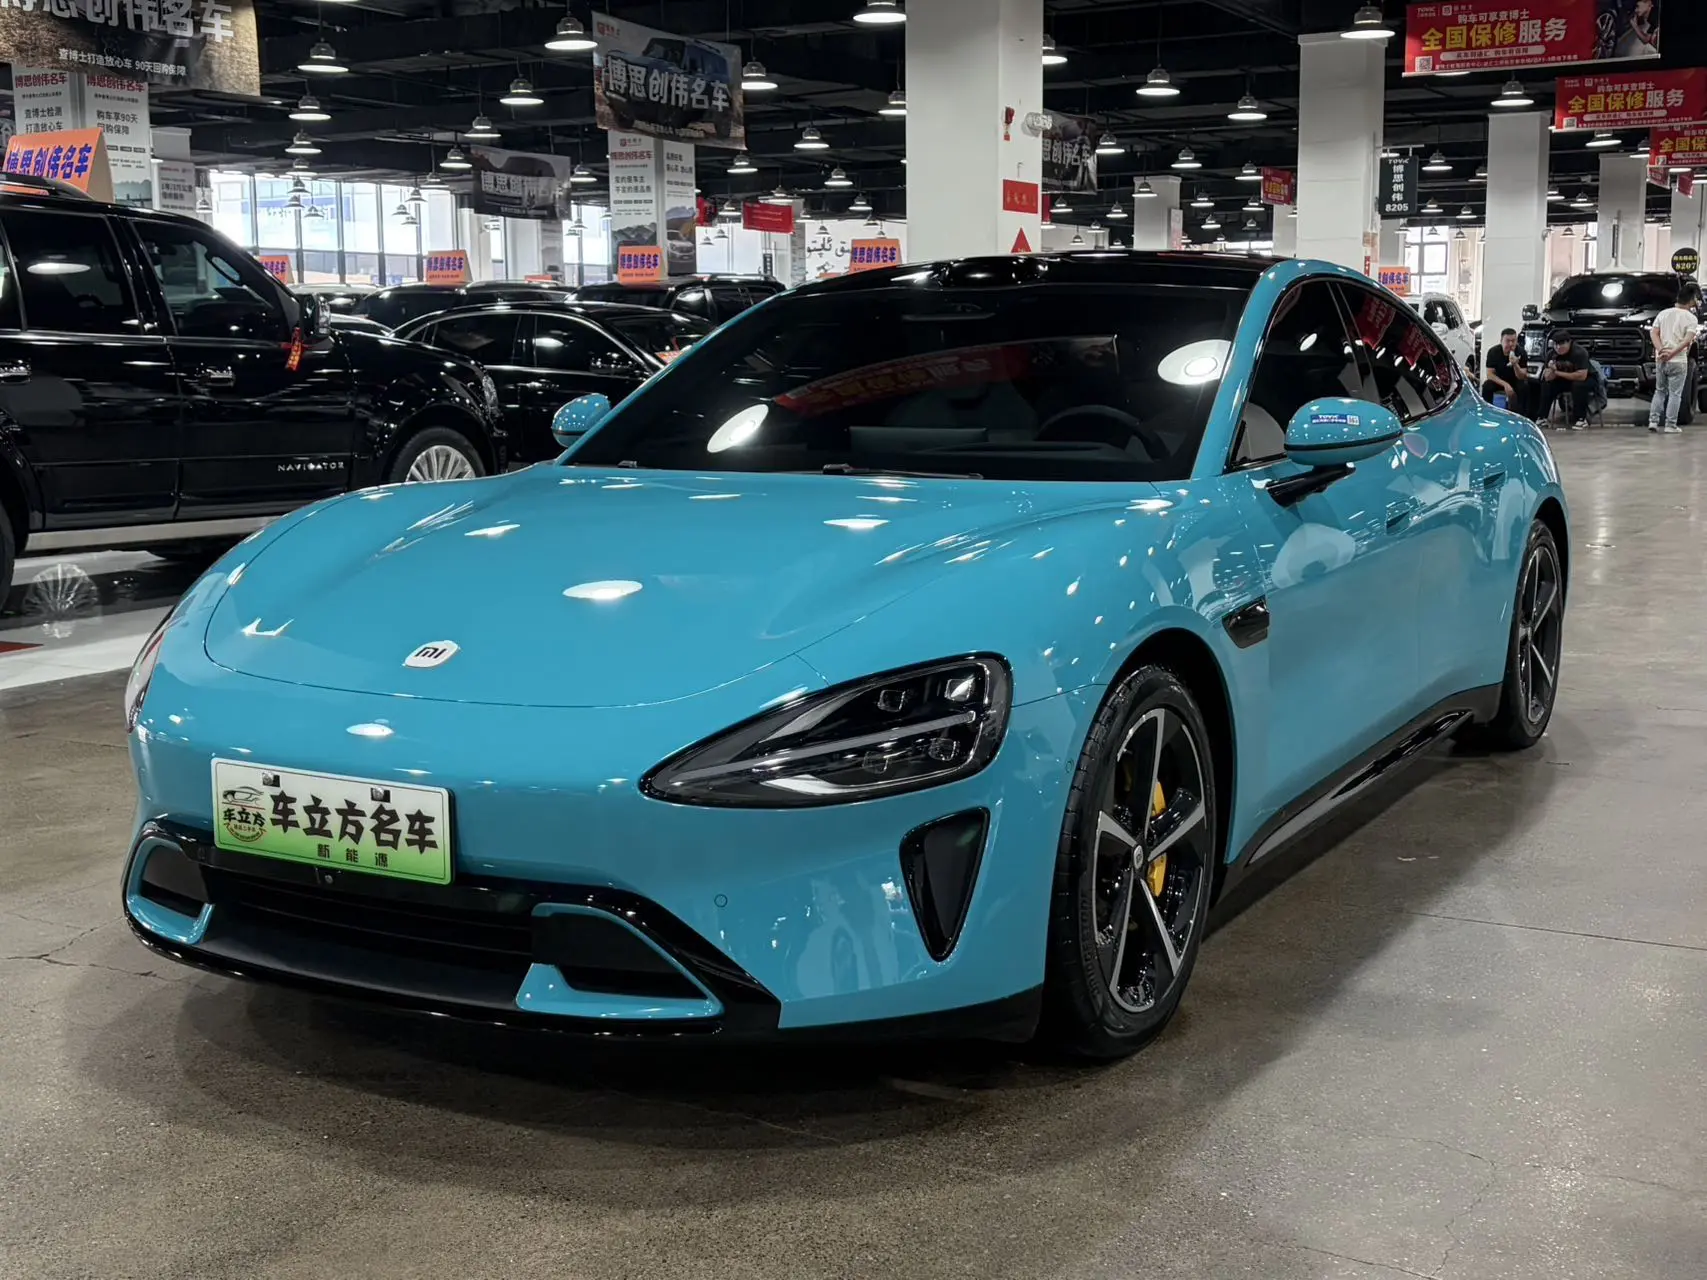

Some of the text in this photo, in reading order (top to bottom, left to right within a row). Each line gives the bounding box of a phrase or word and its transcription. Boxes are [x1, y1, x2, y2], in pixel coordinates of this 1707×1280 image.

[1421, 18, 1568, 51] 全国保修服务
[58, 47, 133, 69] 查博士打造放心车
[602, 55, 731, 112] 博思创伟名车
[1568, 88, 1685, 114] 全国保修服务
[24, 106, 63, 119] 查博士检测
[96, 110, 139, 124] 购车享90天
[1385, 203, 1409, 212] 8205
[277, 461, 345, 472] NAVIGATOR
[222, 807, 266, 828] 车立方
[269, 789, 439, 855] 车立方名车
[316, 843, 389, 868] 新能源
